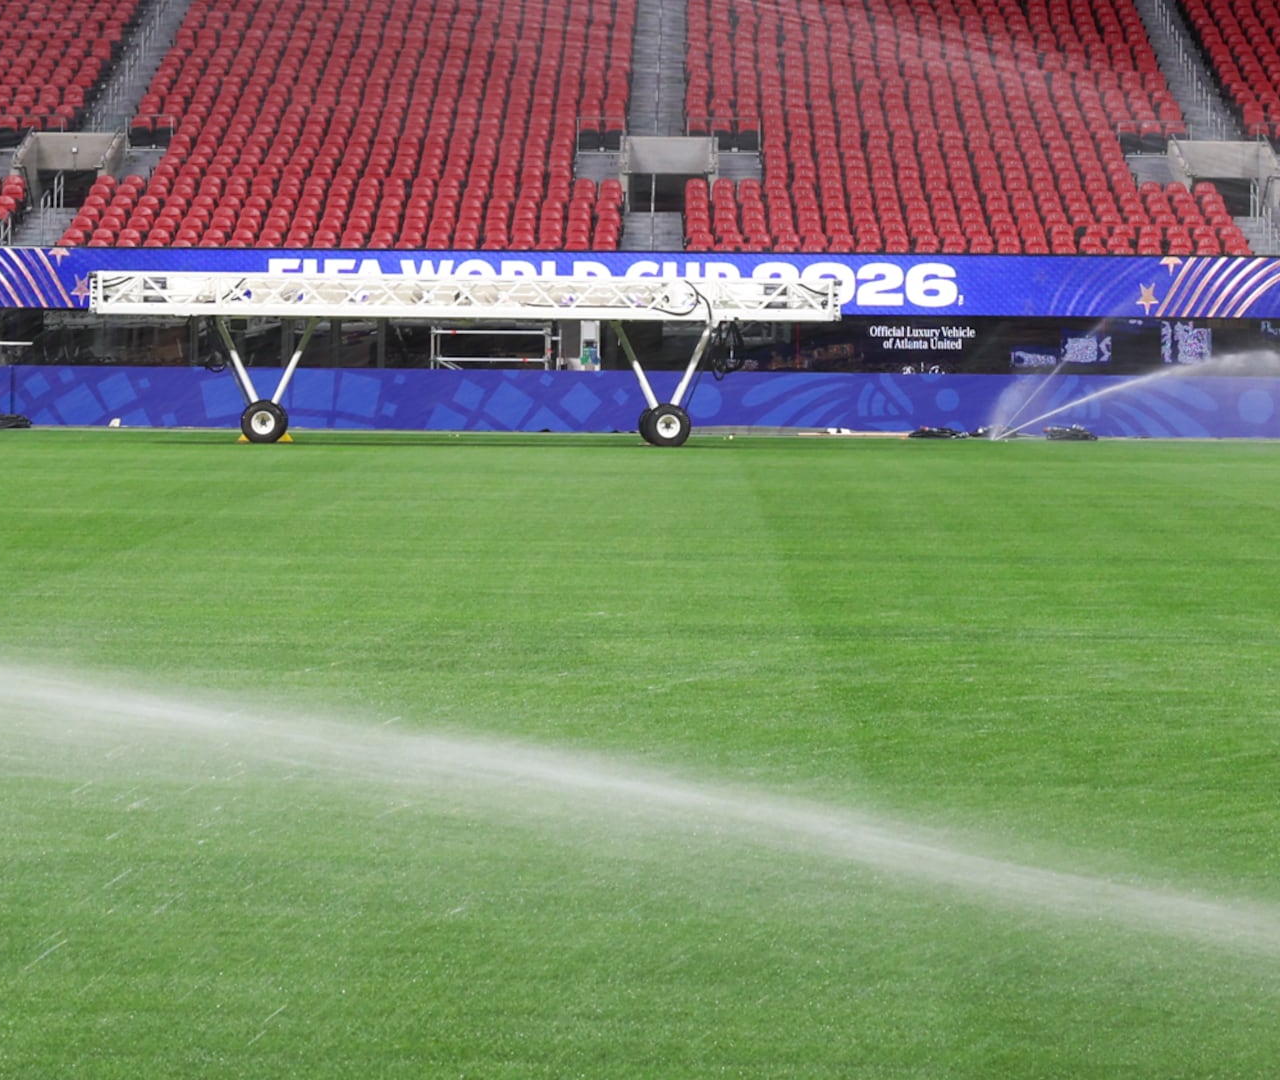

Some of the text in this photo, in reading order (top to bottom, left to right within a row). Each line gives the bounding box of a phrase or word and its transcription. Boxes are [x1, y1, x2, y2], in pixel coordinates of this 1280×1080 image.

[870, 325, 977, 341] Official Luxury Vehicle
[882, 338, 963, 351] of Atlanta United
